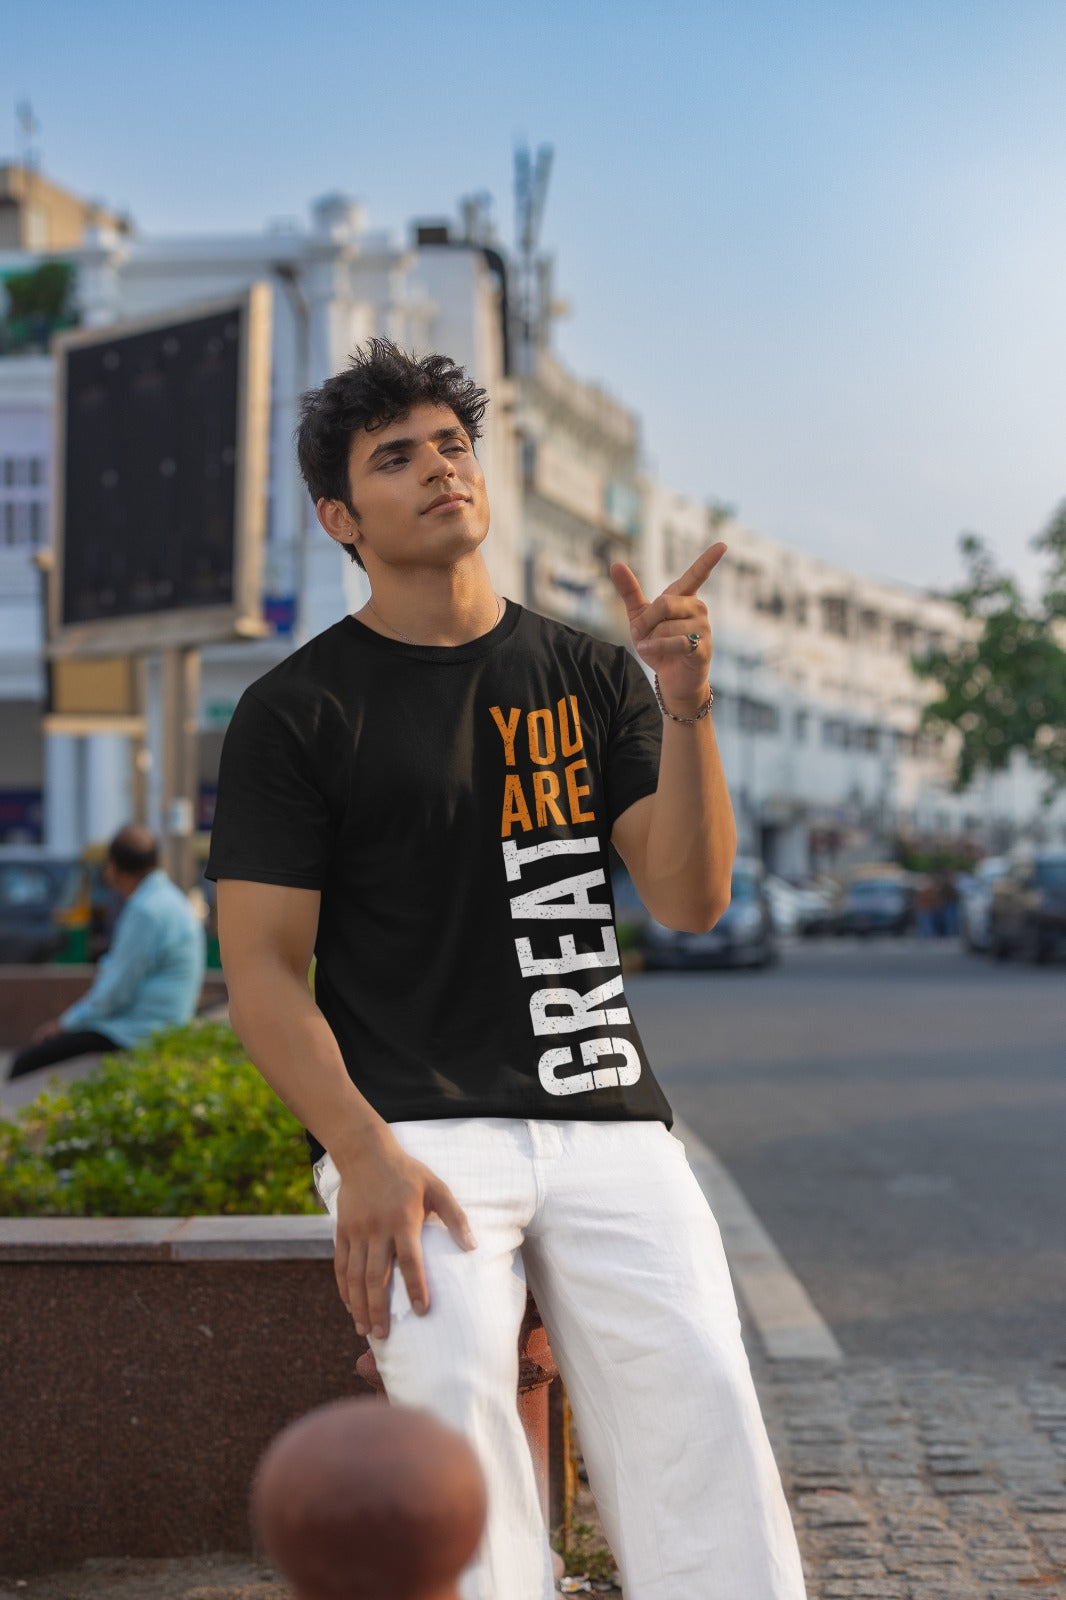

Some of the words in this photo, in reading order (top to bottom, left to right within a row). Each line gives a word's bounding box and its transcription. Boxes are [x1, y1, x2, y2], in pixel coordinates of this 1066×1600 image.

[489, 694, 584, 766] YOU
[501, 759, 595, 838] ARE
[502, 836, 641, 1096] GREAT
